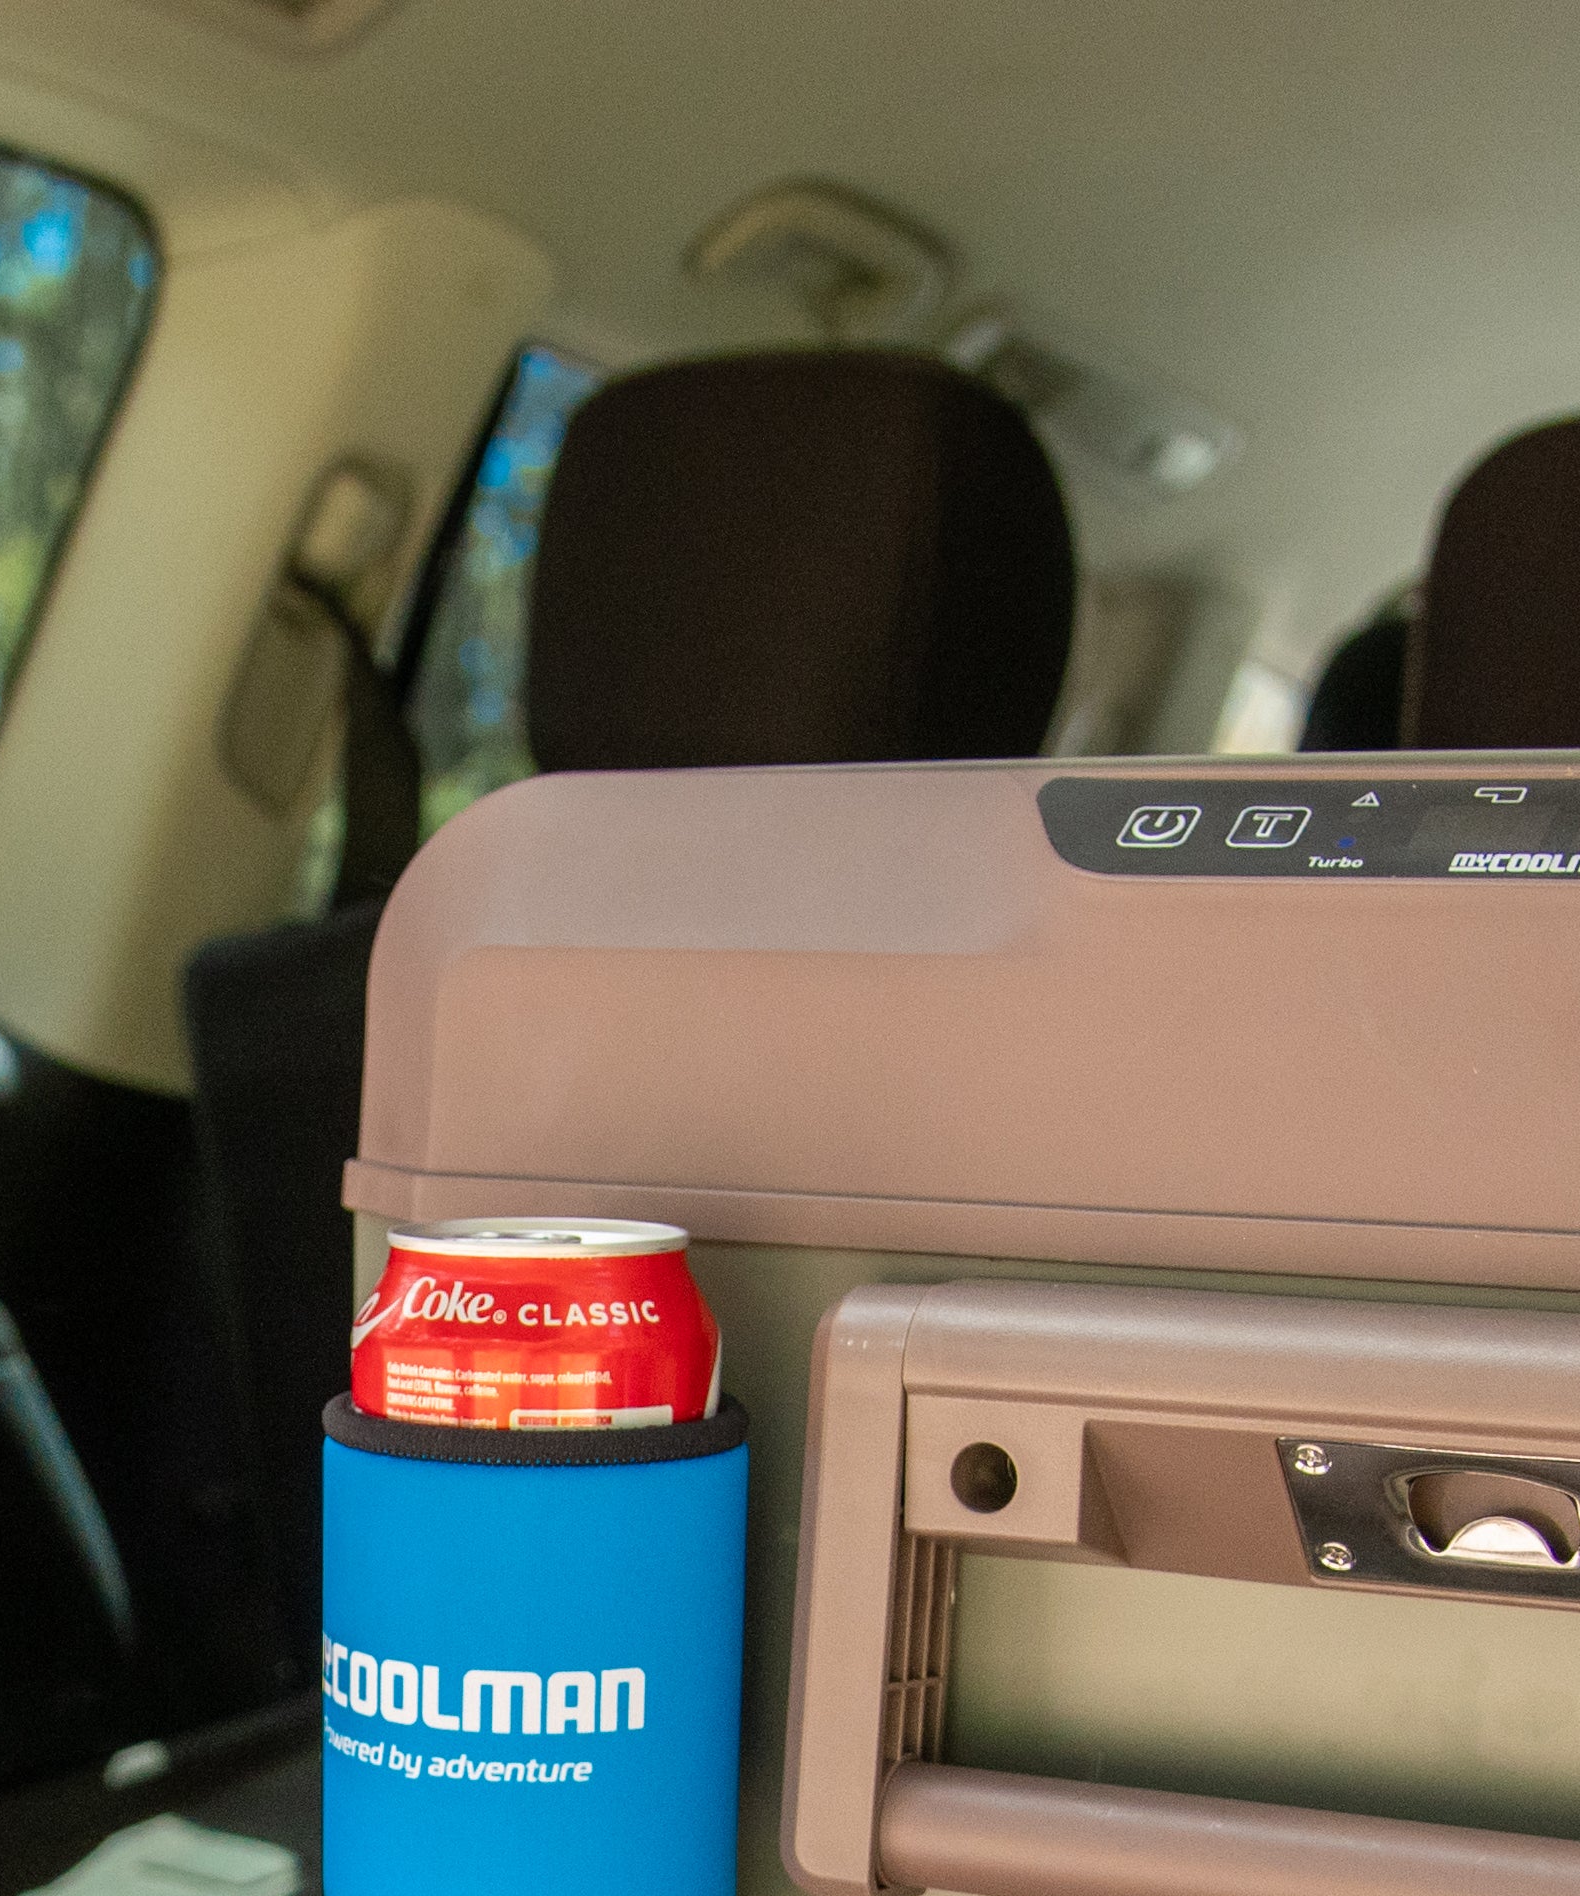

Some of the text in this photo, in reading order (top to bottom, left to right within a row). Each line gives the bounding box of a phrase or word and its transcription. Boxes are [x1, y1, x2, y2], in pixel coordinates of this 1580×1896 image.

[1308, 855, 1364, 870] Turbo
[517, 1299, 661, 1327] CLASSIC
[388, 1745, 423, 1779] by
[427, 1753, 593, 1784] adventure
